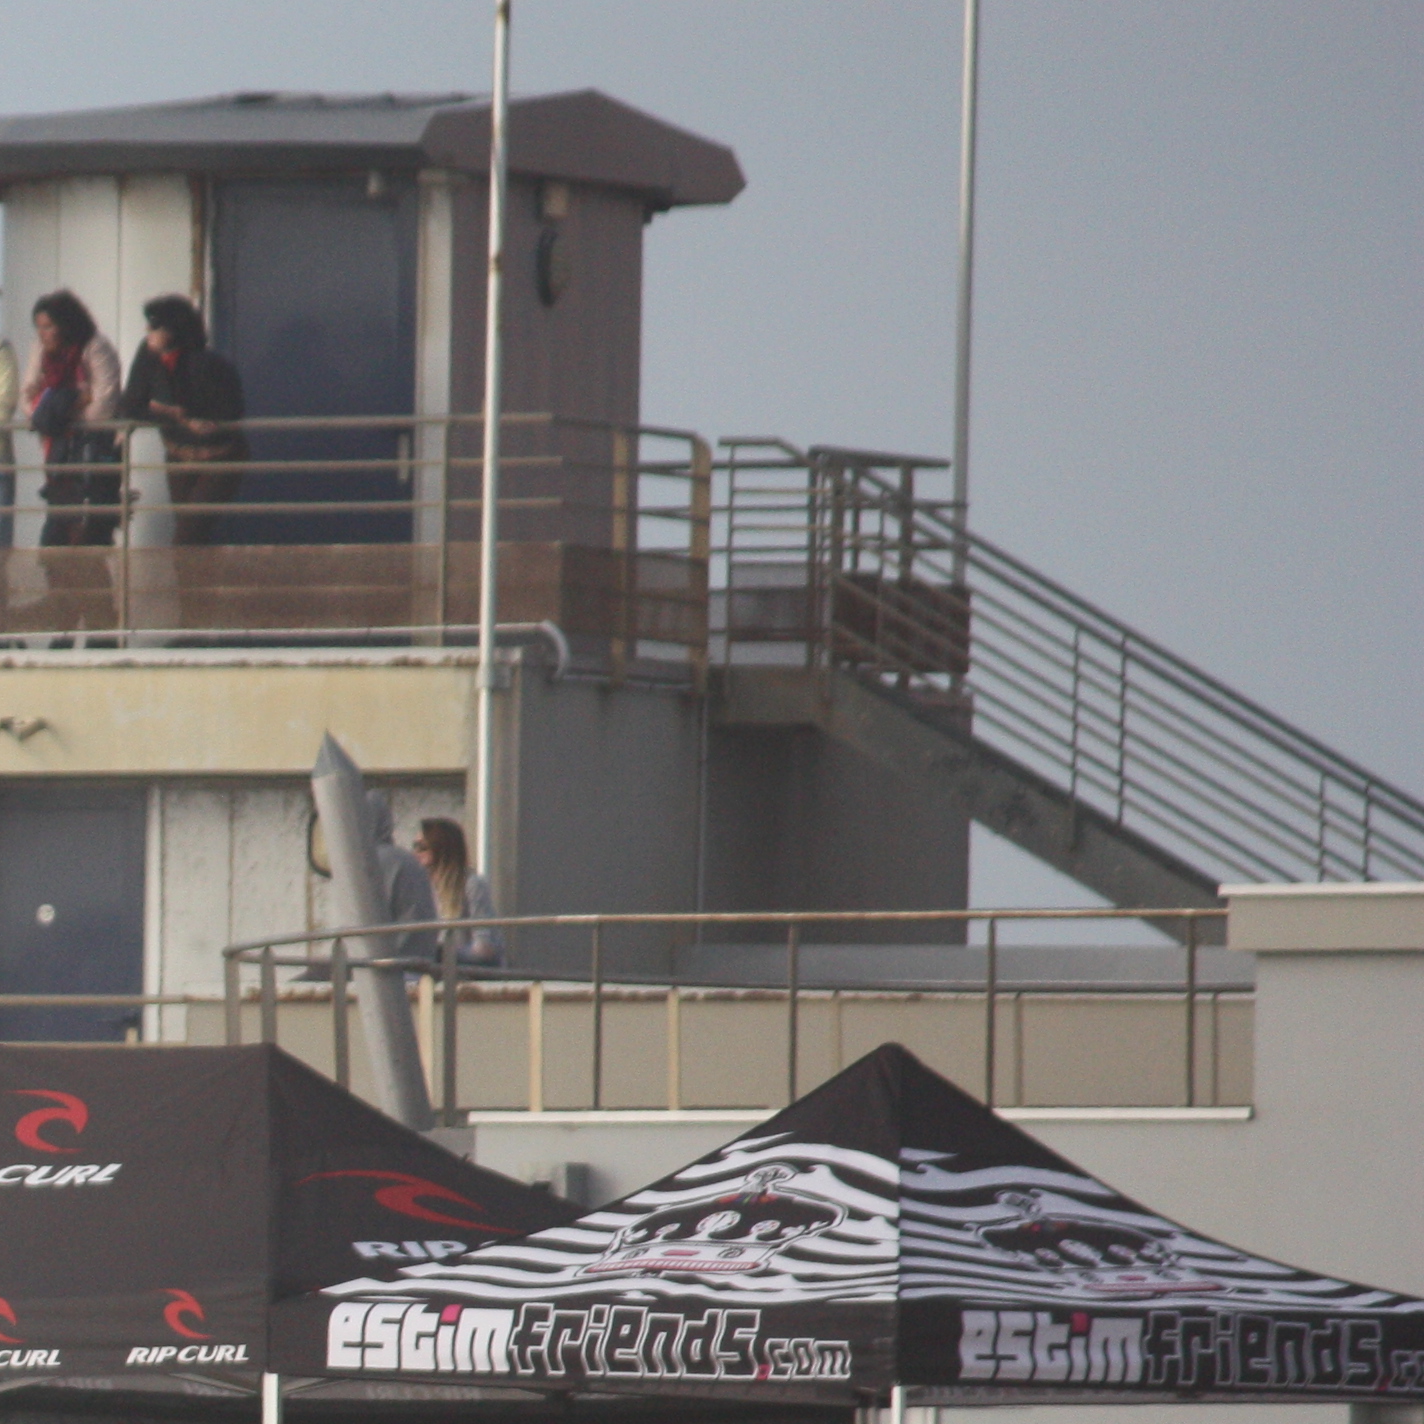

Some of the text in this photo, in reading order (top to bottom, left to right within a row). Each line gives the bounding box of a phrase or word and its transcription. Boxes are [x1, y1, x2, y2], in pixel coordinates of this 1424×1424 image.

[352, 1240, 467, 1258] RIP
[125, 1344, 250, 1365] RIP CURL
